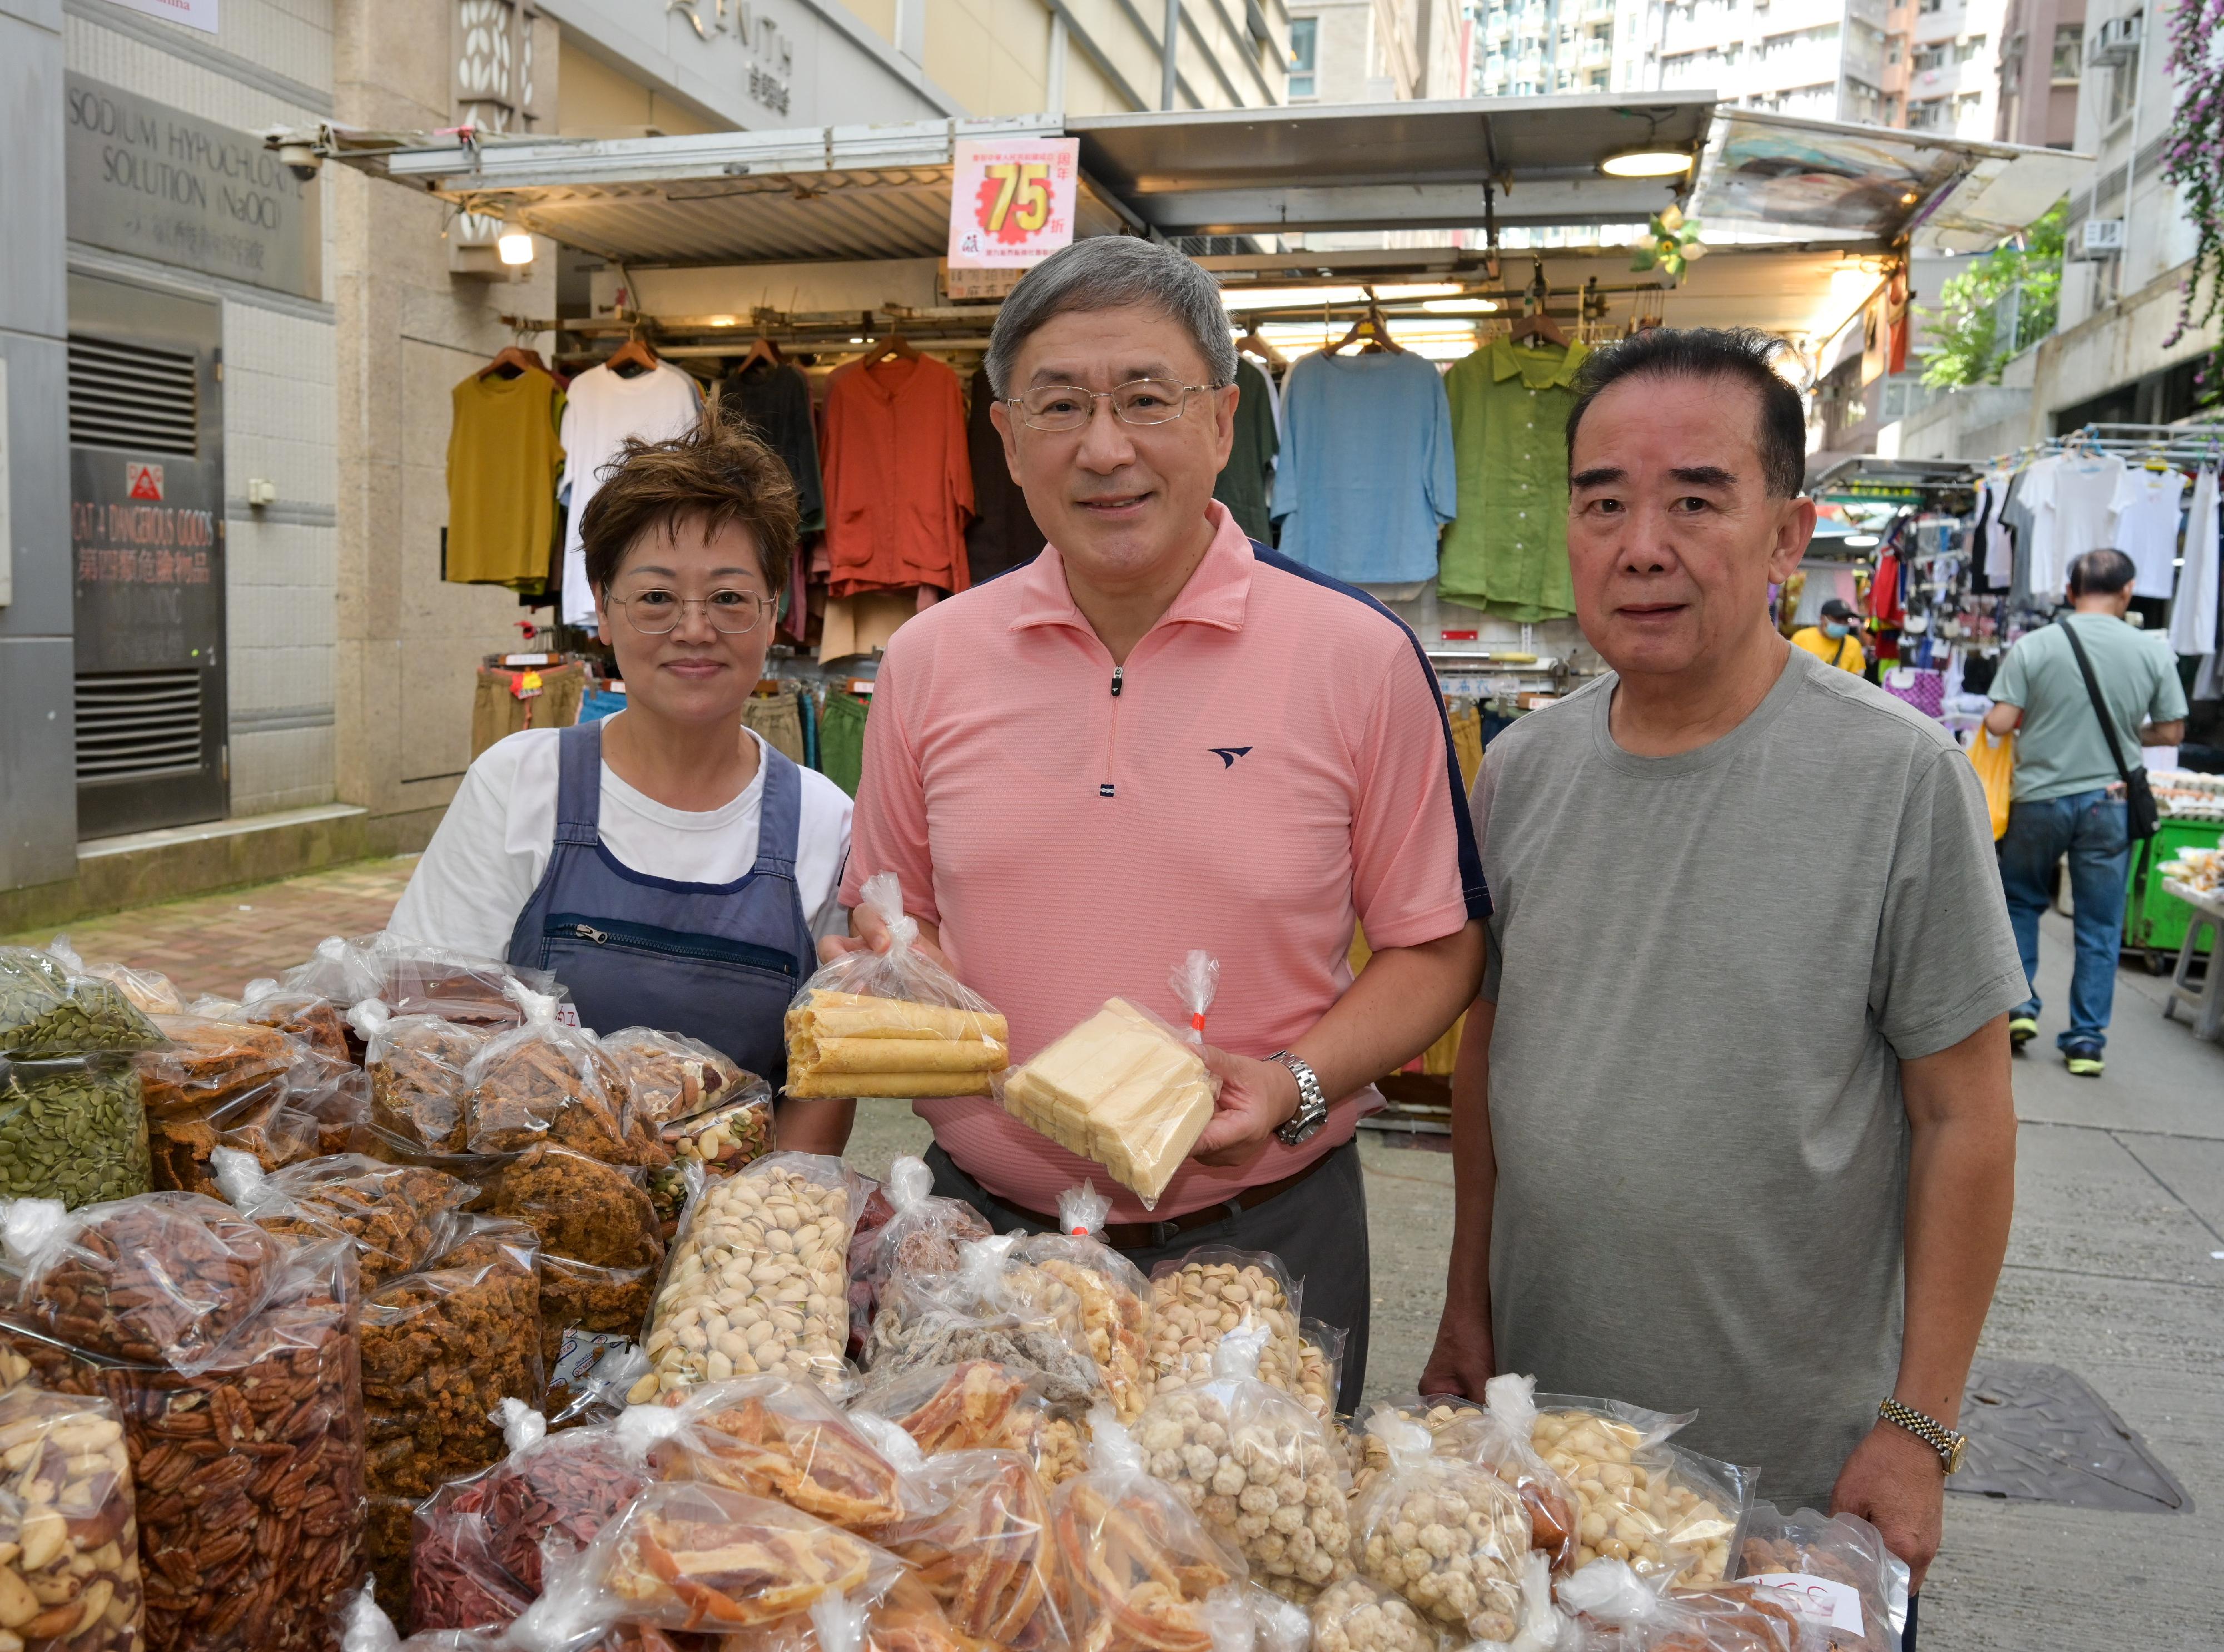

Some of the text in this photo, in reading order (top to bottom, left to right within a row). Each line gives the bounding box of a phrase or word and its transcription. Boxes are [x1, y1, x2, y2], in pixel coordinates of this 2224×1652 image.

[155, 0, 191, 11] hina
[69, 87, 304, 201] SODIUM HYPOCHLOR
[103, 145, 207, 210] SOLUTION
[1057, 152, 1070, 181] 周年
[985, 163, 1050, 232] 75
[1051, 218, 1064, 233] 折
[109, 503, 174, 546] DANGEROUS
[177, 508, 214, 547] GOODS
[575, 1351, 594, 1366] deoxidize
[575, 1359, 593, 1377] DO NOT
